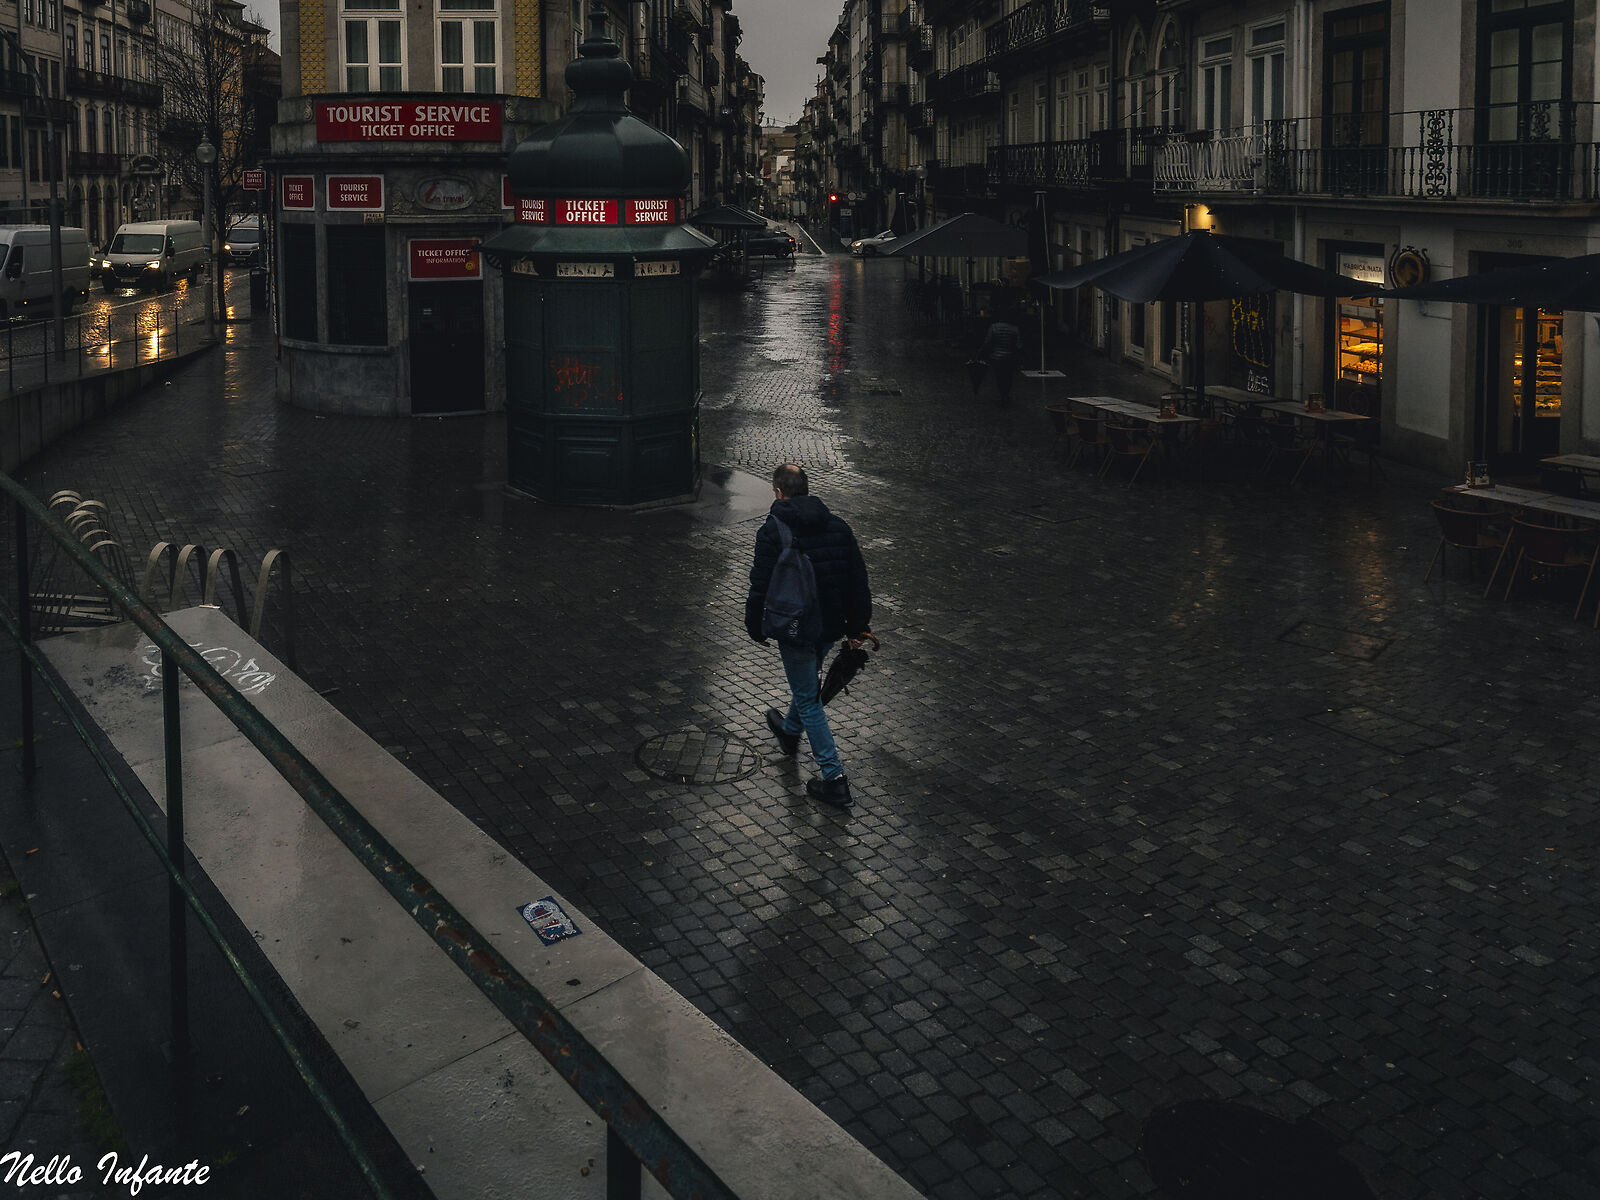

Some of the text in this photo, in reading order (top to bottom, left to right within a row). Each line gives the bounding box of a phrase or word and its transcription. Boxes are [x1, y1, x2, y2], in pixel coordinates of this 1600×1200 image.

[326, 105, 491, 123] TOURIST SERVICE
[360, 124, 455, 137] TICKET OFFICE
[288, 184, 304, 192] TICKET
[339, 183, 369, 192] TOURIST
[288, 193, 304, 201] OFFICE
[340, 193, 369, 202] SERVICE
[521, 199, 545, 210] TOURIST
[565, 200, 606, 211] TICKET
[634, 200, 669, 211] TOURIST
[521, 210, 545, 222] SERVICE
[565, 211, 606, 223] OFFICE
[635, 211, 669, 222] SERVICE
[417, 249, 443, 257] TICKET
